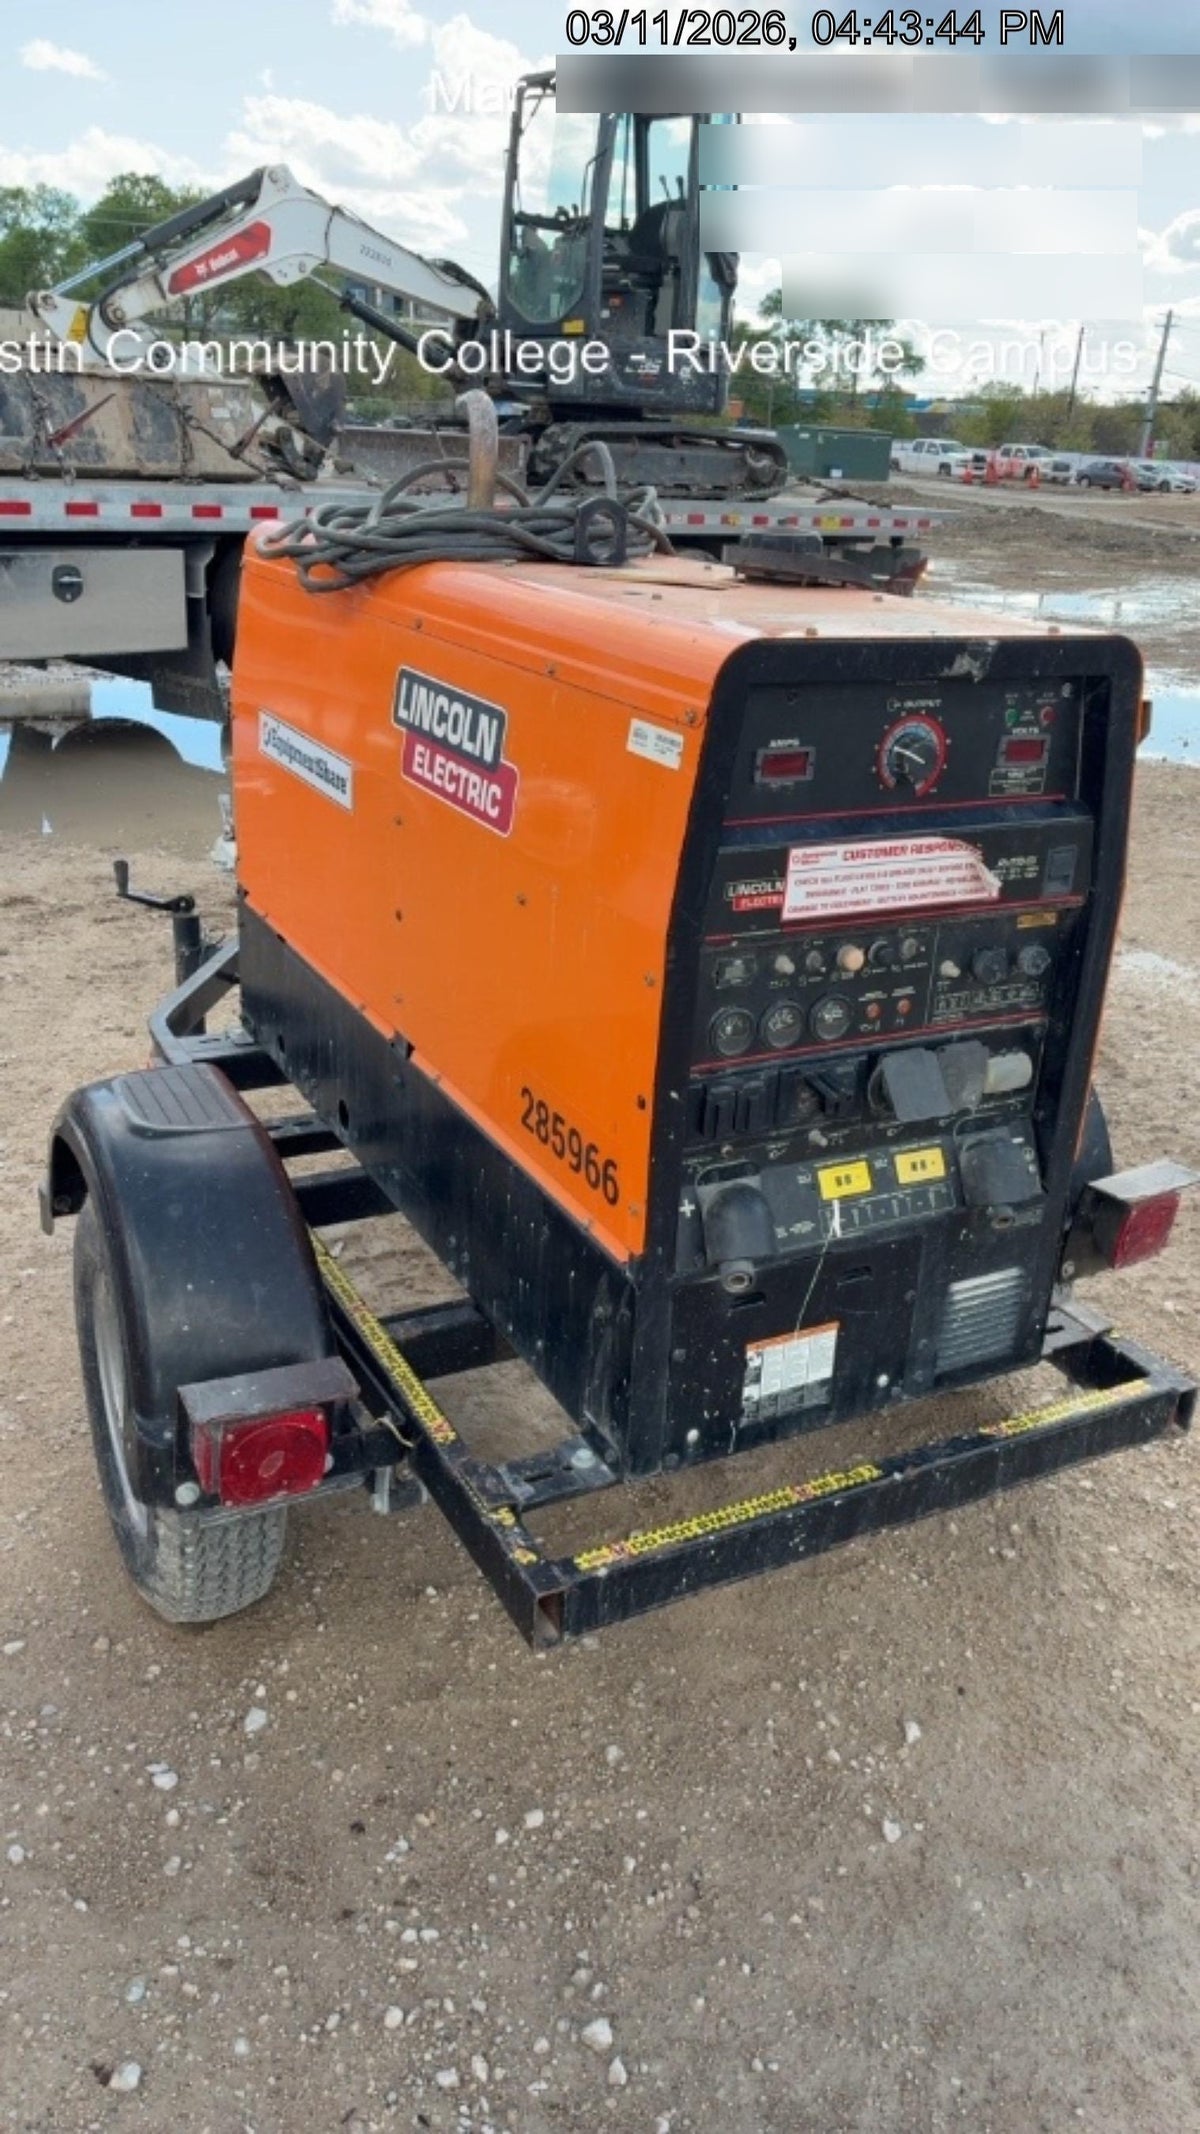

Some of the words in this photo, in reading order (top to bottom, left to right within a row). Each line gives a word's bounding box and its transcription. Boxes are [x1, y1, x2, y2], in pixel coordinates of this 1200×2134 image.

[397, 677, 499, 764] LINCOLN
[411, 743, 502, 819] ELECTRIC
[843, 845, 909, 862] CUSTOMER
[520, 1085, 620, 1207] 285966
